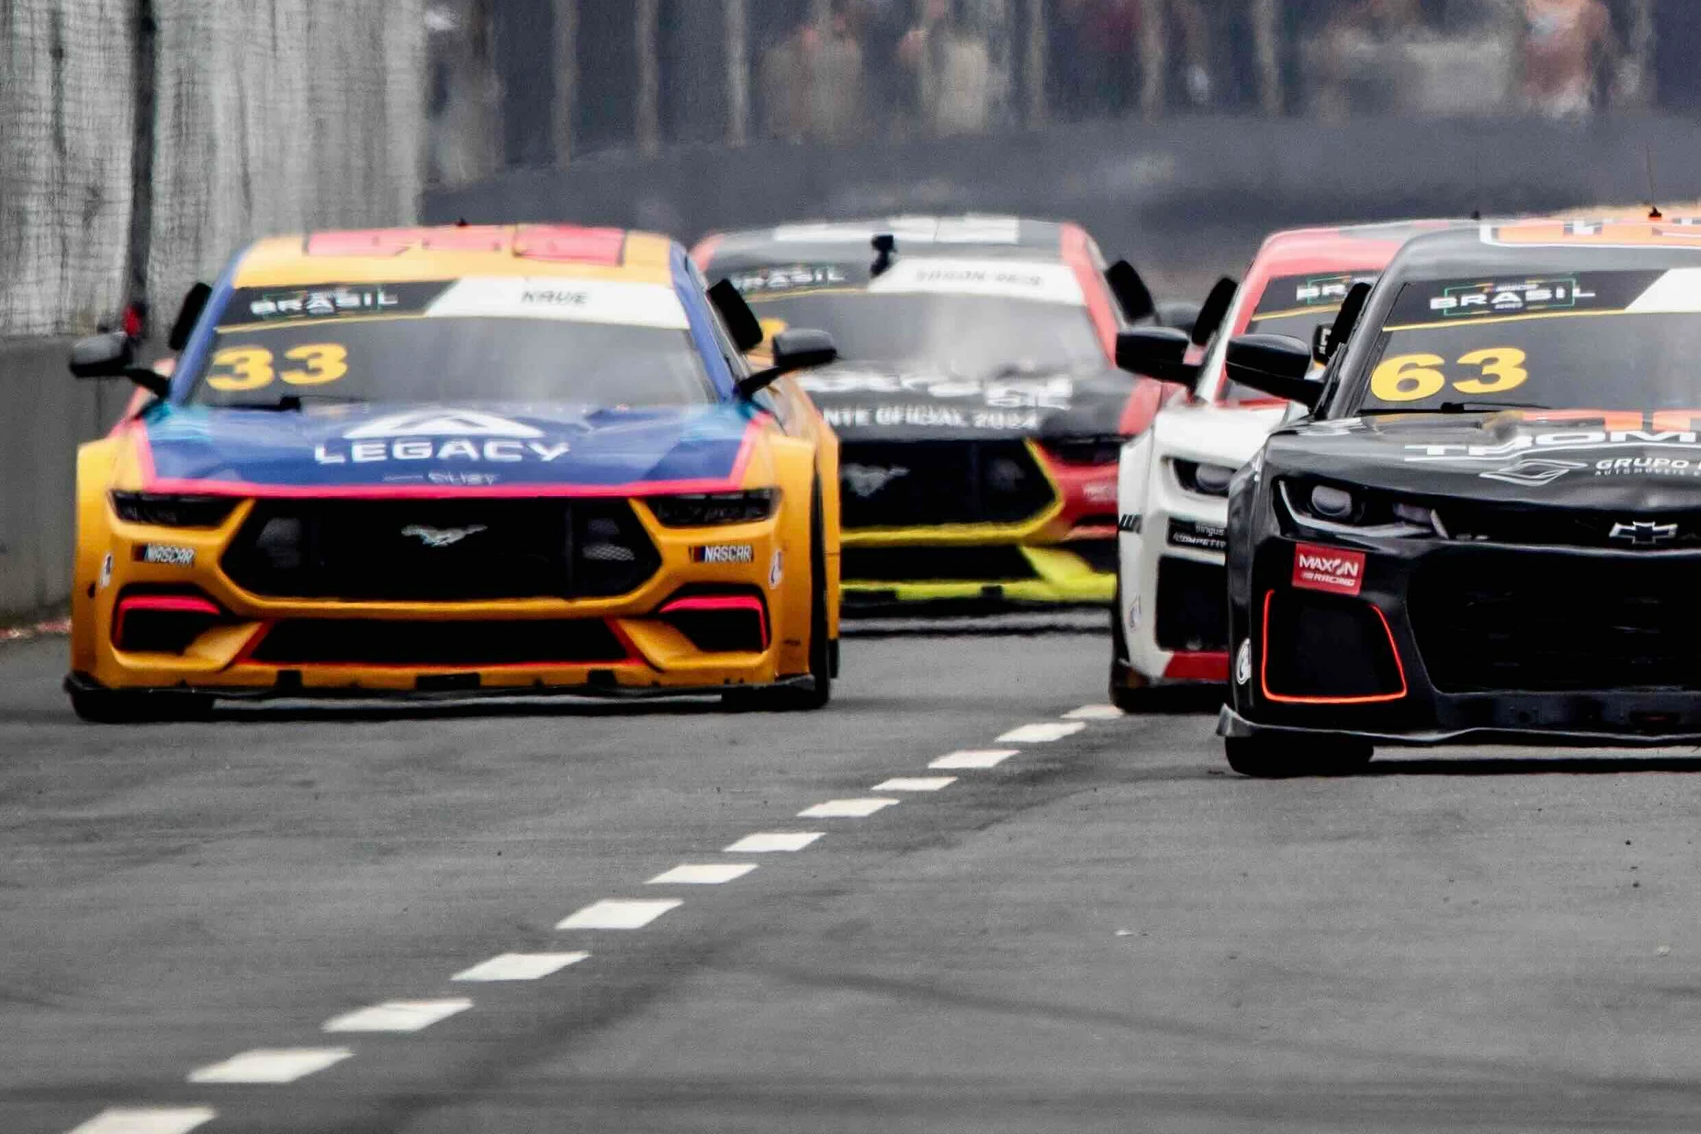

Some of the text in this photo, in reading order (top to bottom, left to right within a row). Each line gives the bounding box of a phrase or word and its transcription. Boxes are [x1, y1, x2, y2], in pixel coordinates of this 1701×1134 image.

[1430, 287, 1596, 309] BRASIL
[206, 342, 348, 392] 33
[1370, 347, 1529, 402] 63
[313, 440, 571, 465] LEGACY
[1596, 457, 1690, 471] GRUPO
[704, 545, 752, 563] NASCAR
[1299, 553, 1359, 577] MAXON
[1313, 572, 1356, 587] RACING
